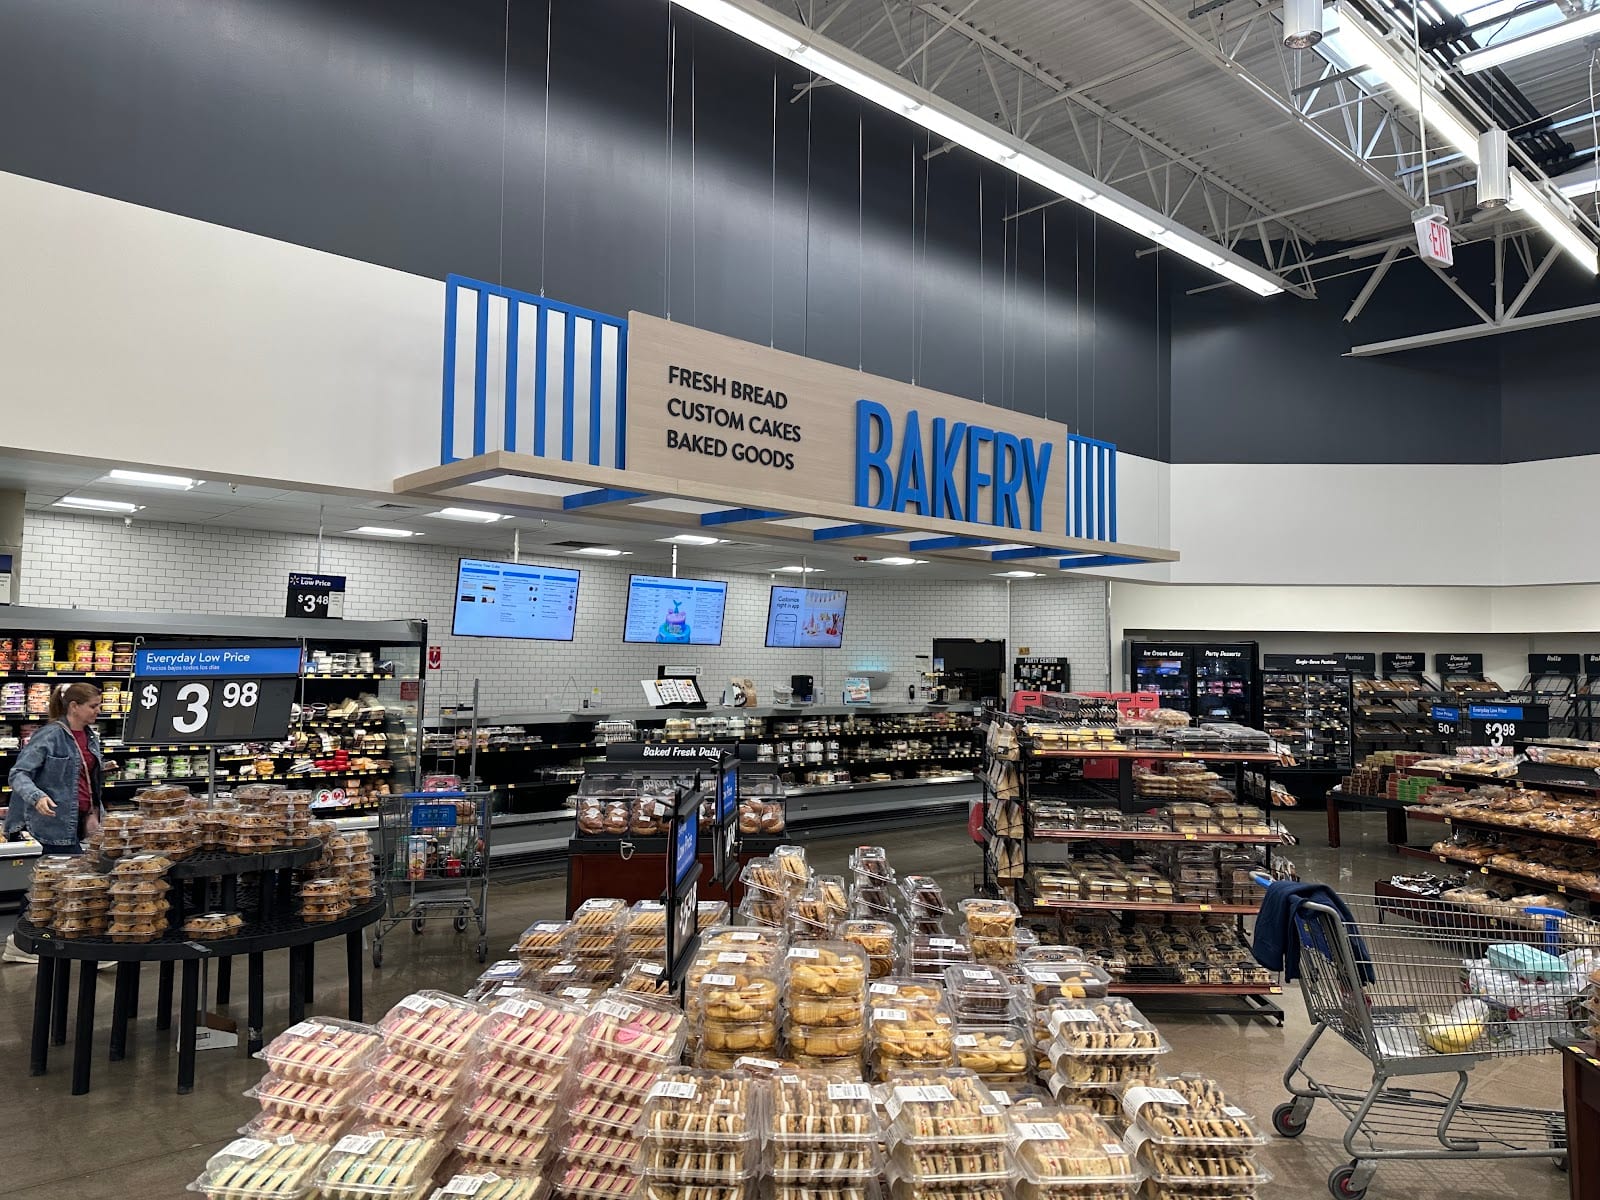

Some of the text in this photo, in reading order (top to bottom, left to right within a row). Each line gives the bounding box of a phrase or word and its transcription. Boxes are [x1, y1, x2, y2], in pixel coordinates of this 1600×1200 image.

[1430, 222, 1450, 261] EXIT
[668, 365, 788, 410] FRESH BREAD
[667, 397, 801, 443] CUSTOM CAKES
[667, 429, 795, 470] BAKED GOODS
[855, 399, 1053, 533] BAKERY
[146, 652, 250, 666] Everyday Low Price
[1205, 650, 1219, 658] Party
[643, 746, 721, 760] Baked Fresh Daily
